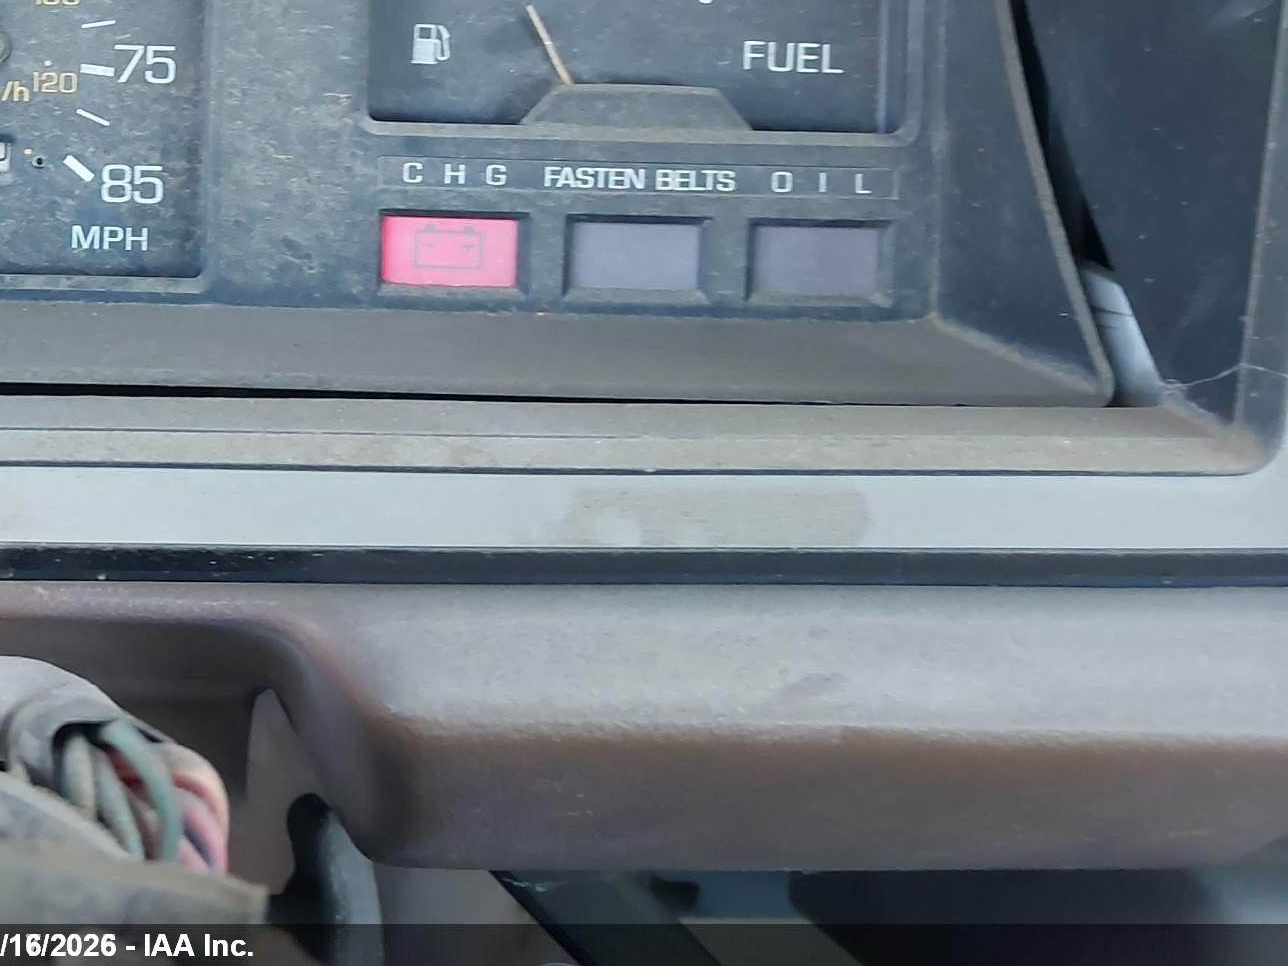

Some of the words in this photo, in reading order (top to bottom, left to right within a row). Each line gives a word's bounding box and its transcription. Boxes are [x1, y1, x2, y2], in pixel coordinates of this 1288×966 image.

[114, 44, 177, 84] 75
[743, 40, 843, 75] FUEL
[32, 72, 78, 95] 120
[100, 165, 164, 204] 85
[543, 165, 646, 191] FASTEN
[654, 169, 737, 193] BELTS
[71, 225, 149, 251] MPH
